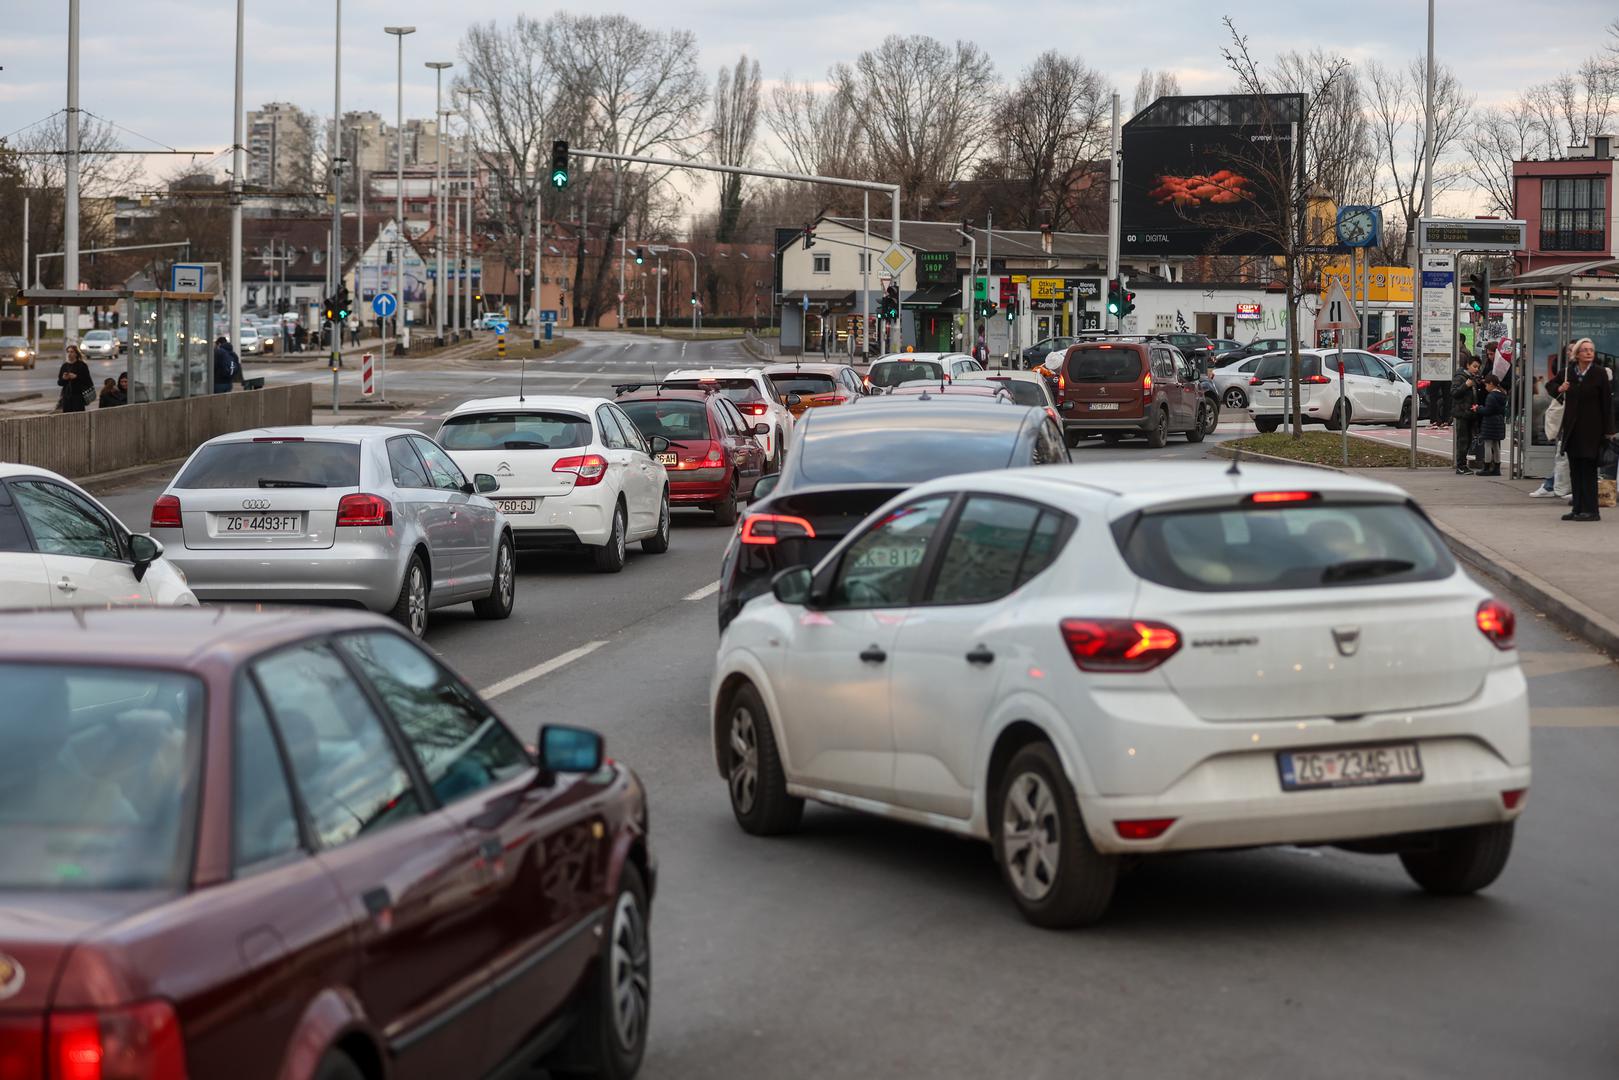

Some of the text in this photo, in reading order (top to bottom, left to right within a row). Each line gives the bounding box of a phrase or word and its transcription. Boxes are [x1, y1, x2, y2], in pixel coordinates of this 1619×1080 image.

[1127, 234, 1170, 243] GO DIGITAL
[925, 263, 943, 271] SHOP
[657, 453, 676, 463] 6-AH
[227, 517, 242, 530] ZG
[1295, 754, 1324, 781] ZG
